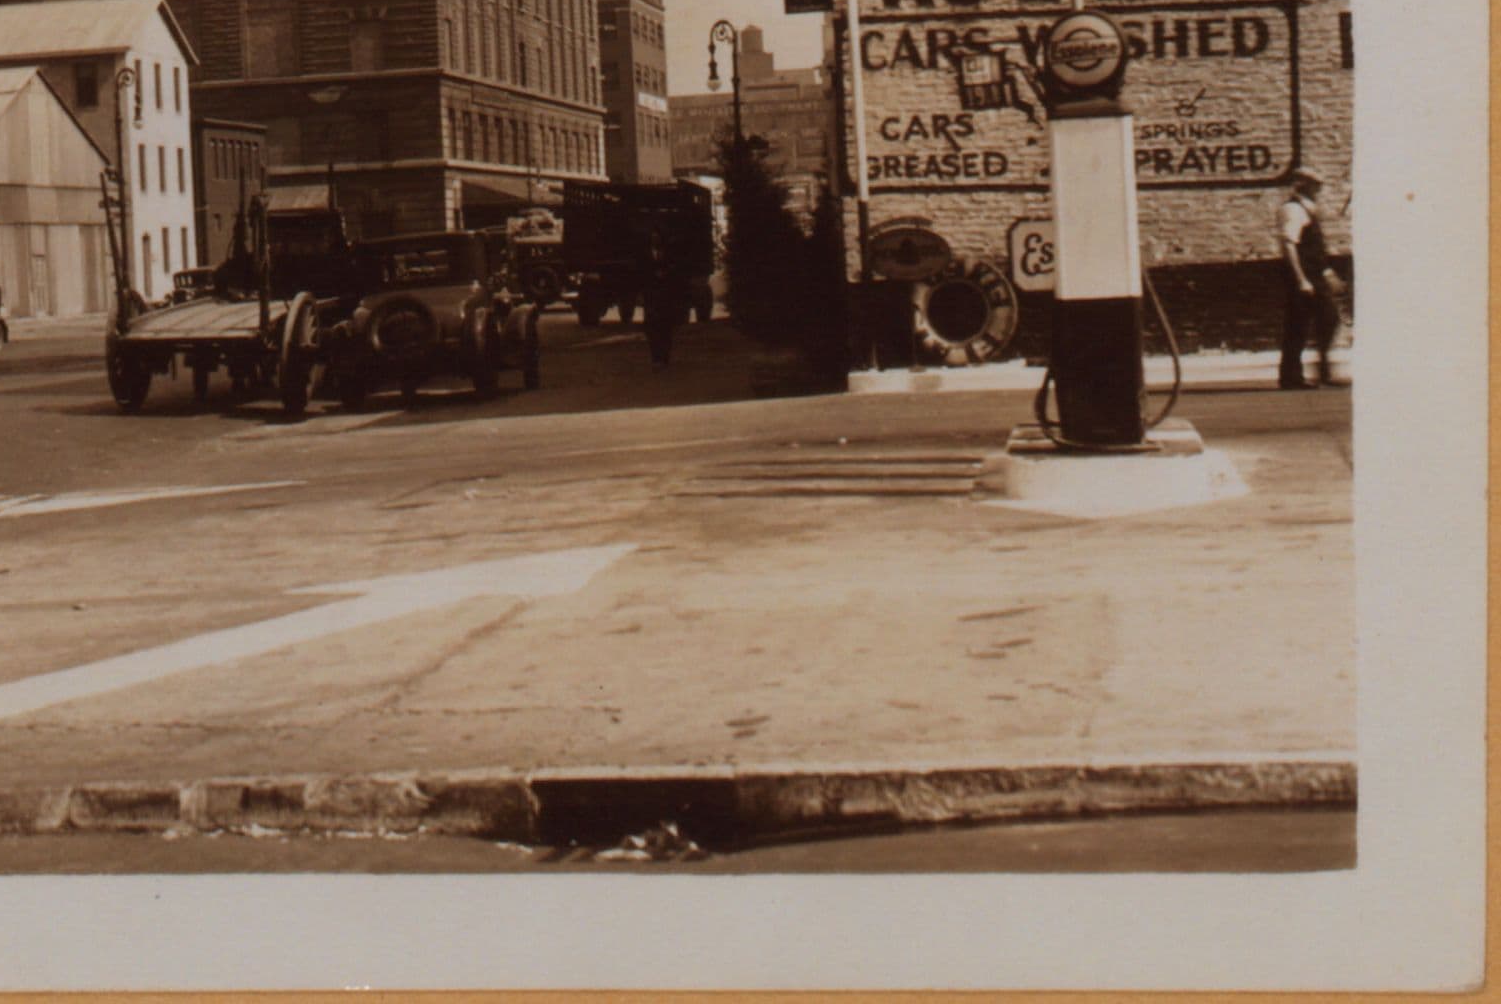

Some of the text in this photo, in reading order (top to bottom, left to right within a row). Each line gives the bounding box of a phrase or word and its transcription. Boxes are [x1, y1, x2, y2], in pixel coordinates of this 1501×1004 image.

[860, 17, 1271, 72] CARS WSHED
[880, 113, 975, 152] CARS
[1140, 120, 1241, 145] SPRINGS
[1134, 144, 1280, 175] PRAYED.
[1021, 233, 1055, 276] Es
